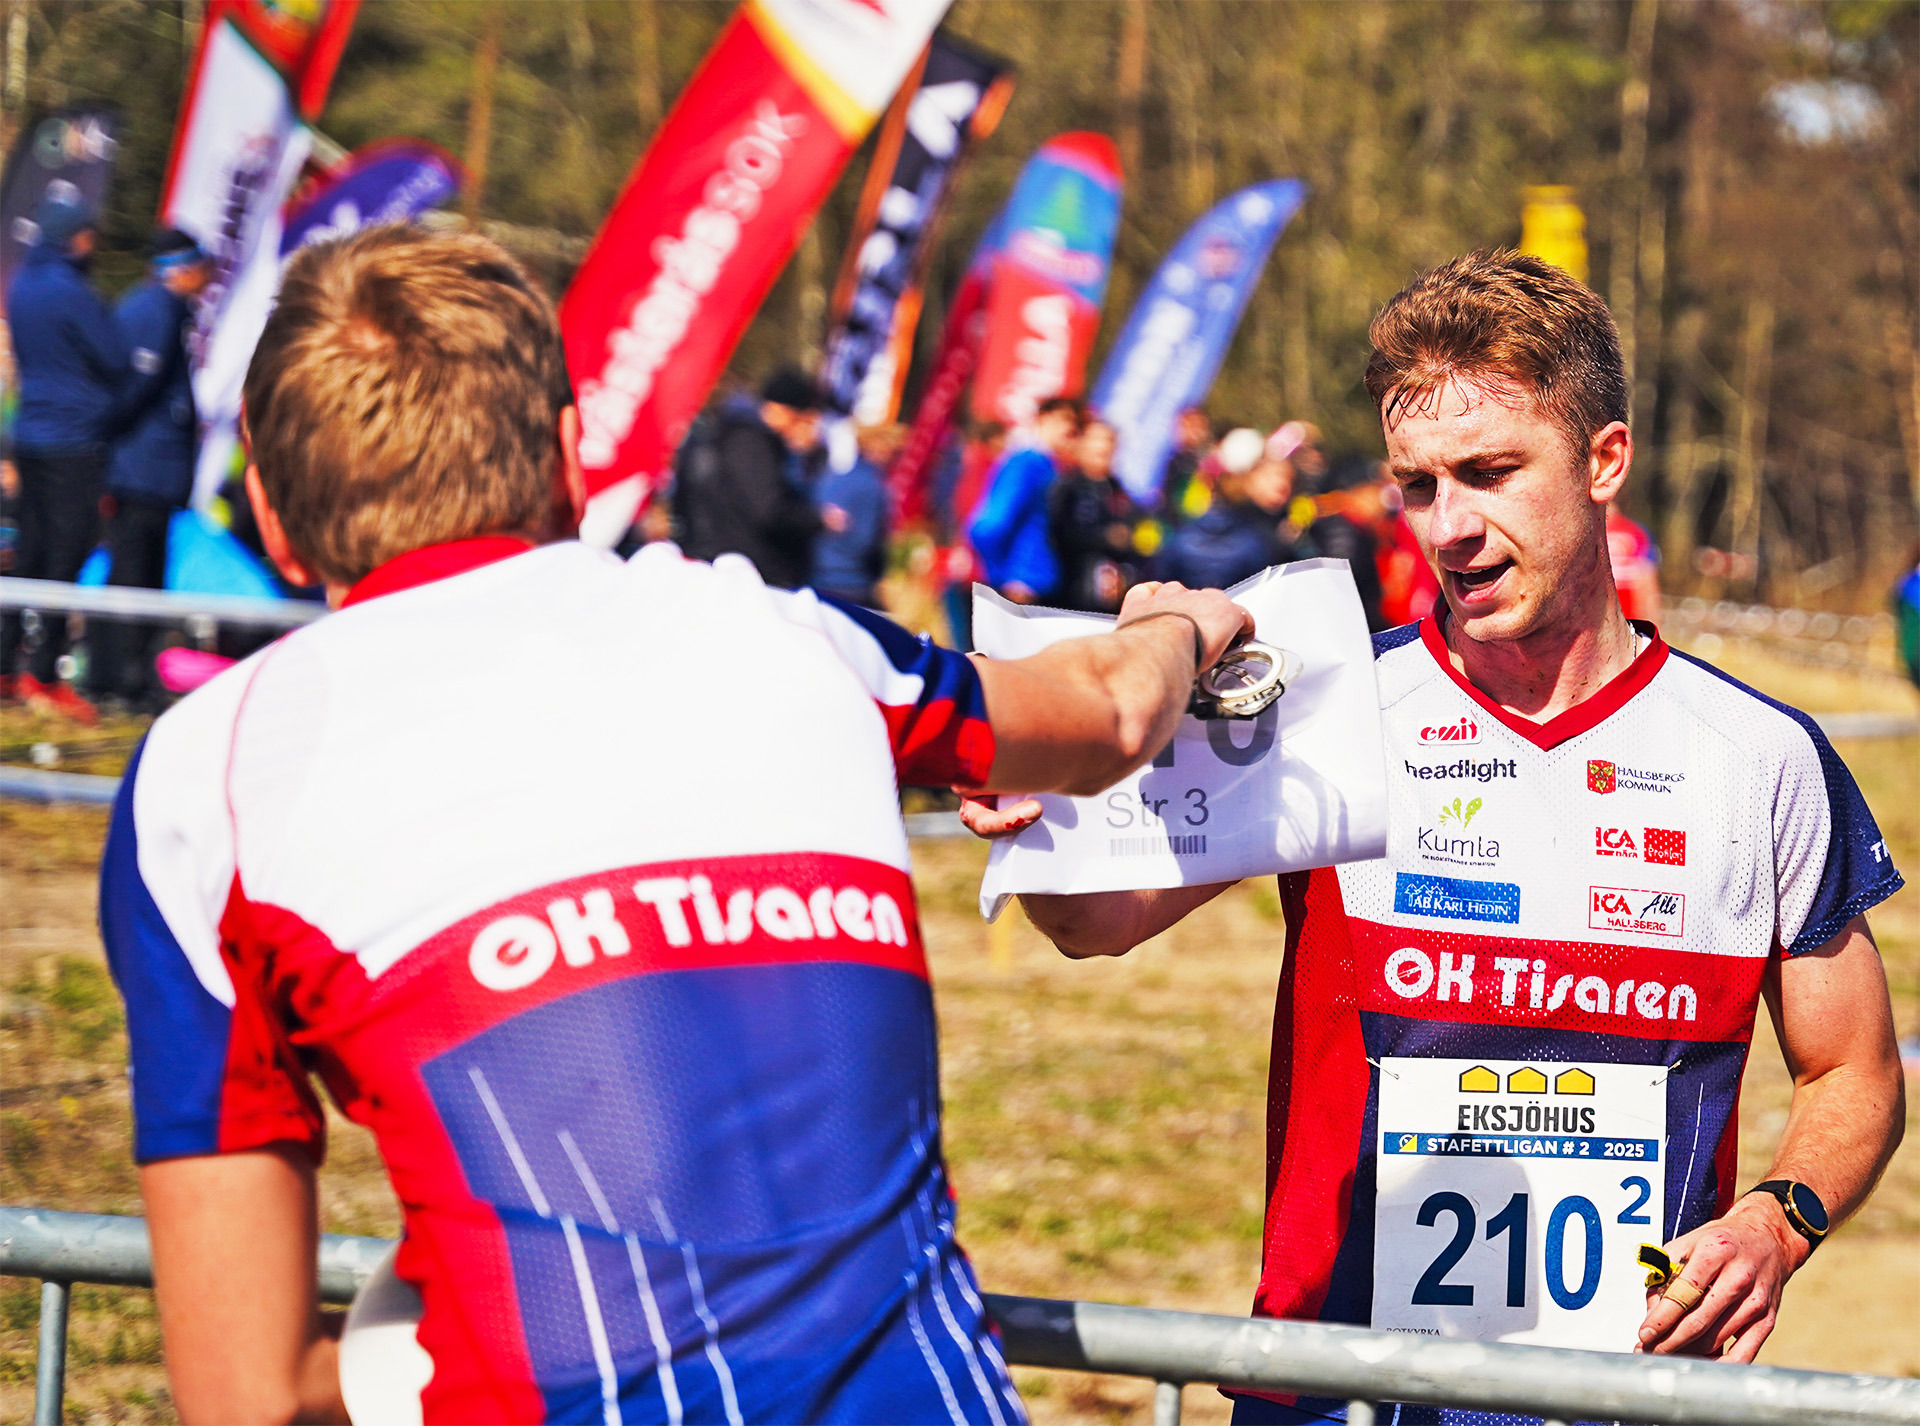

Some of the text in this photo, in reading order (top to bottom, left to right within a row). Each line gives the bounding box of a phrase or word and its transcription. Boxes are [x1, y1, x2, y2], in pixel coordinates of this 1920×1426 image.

[1420, 716, 1478, 741] emit
[1404, 758, 1517, 783] headlight
[1617, 766, 1685, 783] HALLSBERGS
[1617, 779, 1672, 794] KOMMUN
[1105, 790, 1169, 829] Str
[1183, 788, 1209, 827] 3
[1418, 826, 1500, 858] Kumla
[1595, 827, 1638, 850] ICA
[1413, 895, 1509, 916] AB KARL HEDIN
[1593, 891, 1680, 920] ICA Allé
[468, 874, 909, 992] OK Tisaren
[1607, 917, 1667, 932] HALLSBERG
[1384, 947, 1697, 1022] OK Tisaren
[1457, 1100, 1596, 1134] EKSJÖHUS
[1426, 1137, 1559, 1156] STAFETTLIGAN
[1603, 1142, 1645, 1158] 2025
[1411, 1175, 1652, 1311] 210 2
